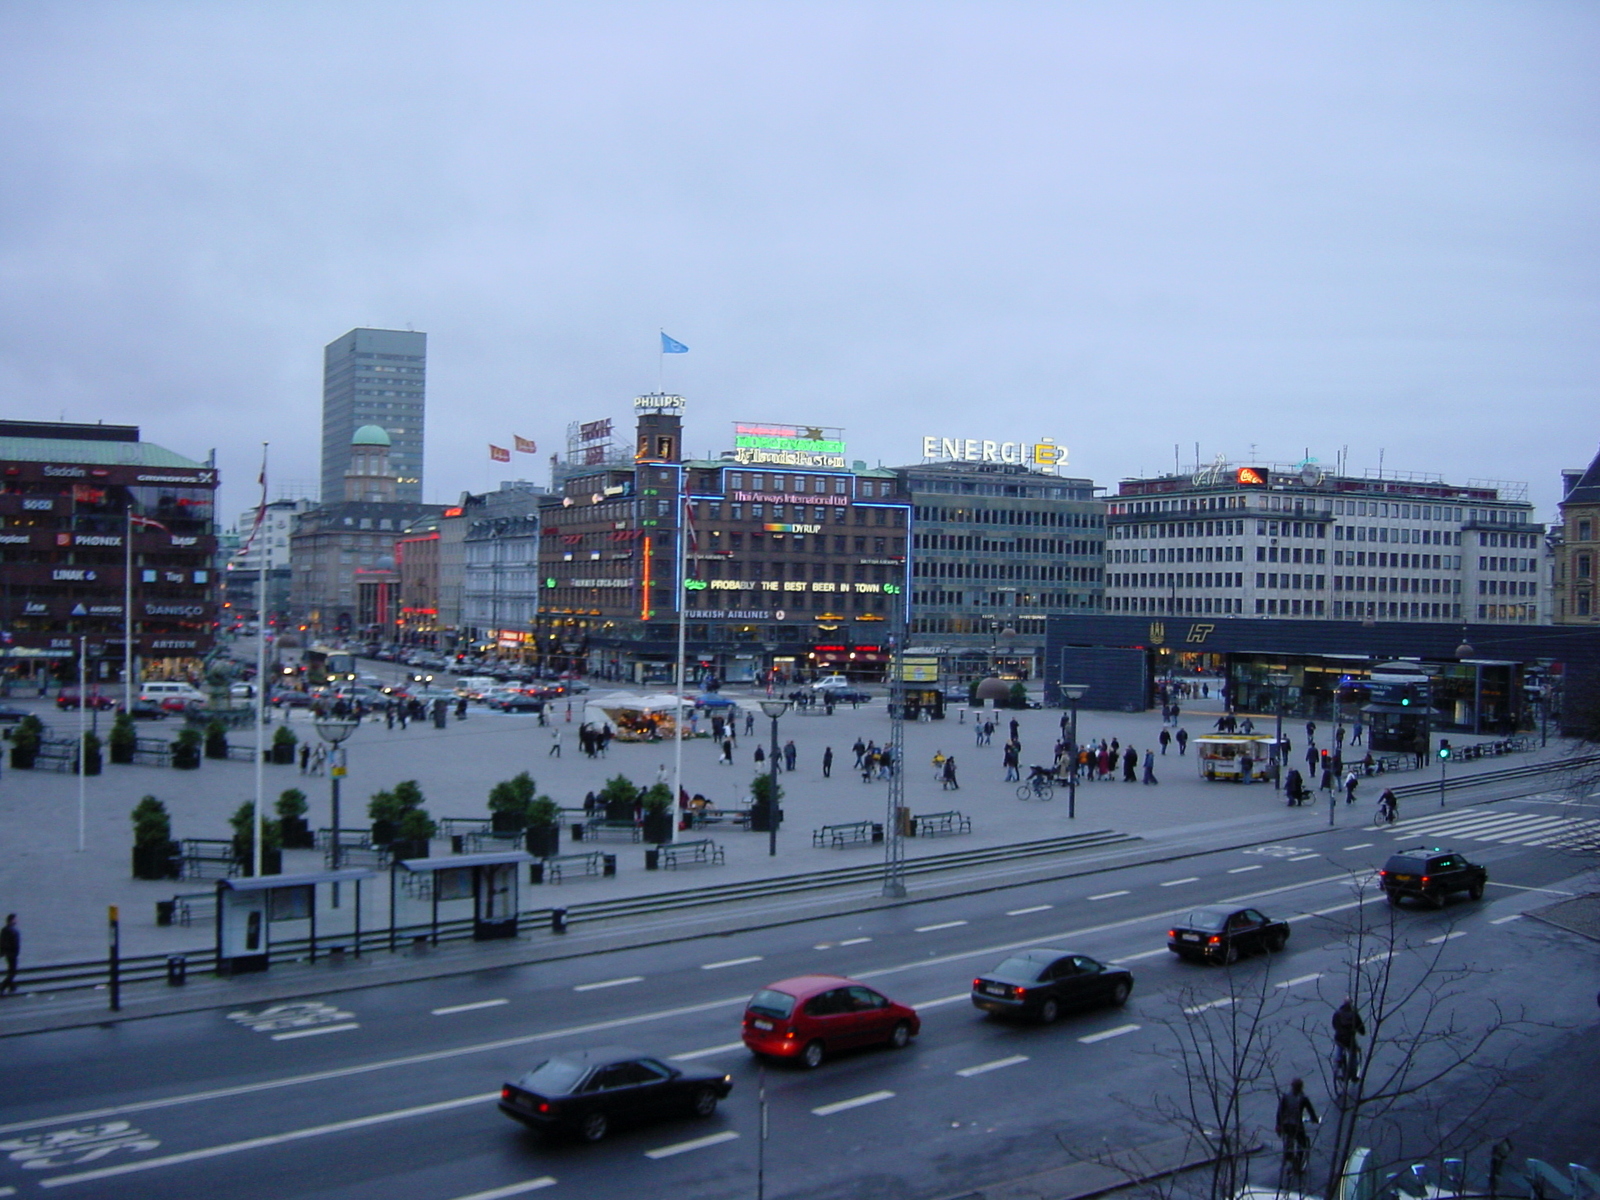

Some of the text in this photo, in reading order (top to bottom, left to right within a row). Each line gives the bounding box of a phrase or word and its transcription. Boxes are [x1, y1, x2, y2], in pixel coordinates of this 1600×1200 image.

[634, 396, 680, 407] PHILIPS
[923, 436, 1026, 463] ENERGI
[44, 465, 86, 477] Sadolin
[137, 475, 198, 483] GRUNDFOS
[733, 491, 847, 506] Thai Airways International Ltd
[792, 523, 821, 533] DYRUP
[53, 569, 85, 580] LINAK
[710, 580, 755, 590] PROBABLY
[761, 581, 779, 591] THE
[784, 581, 807, 591] BEST
[812, 582, 835, 592] BEER
[840, 583, 850, 592] IN
[854, 583, 880, 593] TOWN
[685, 610, 769, 619] TURKISH AIRLINES
